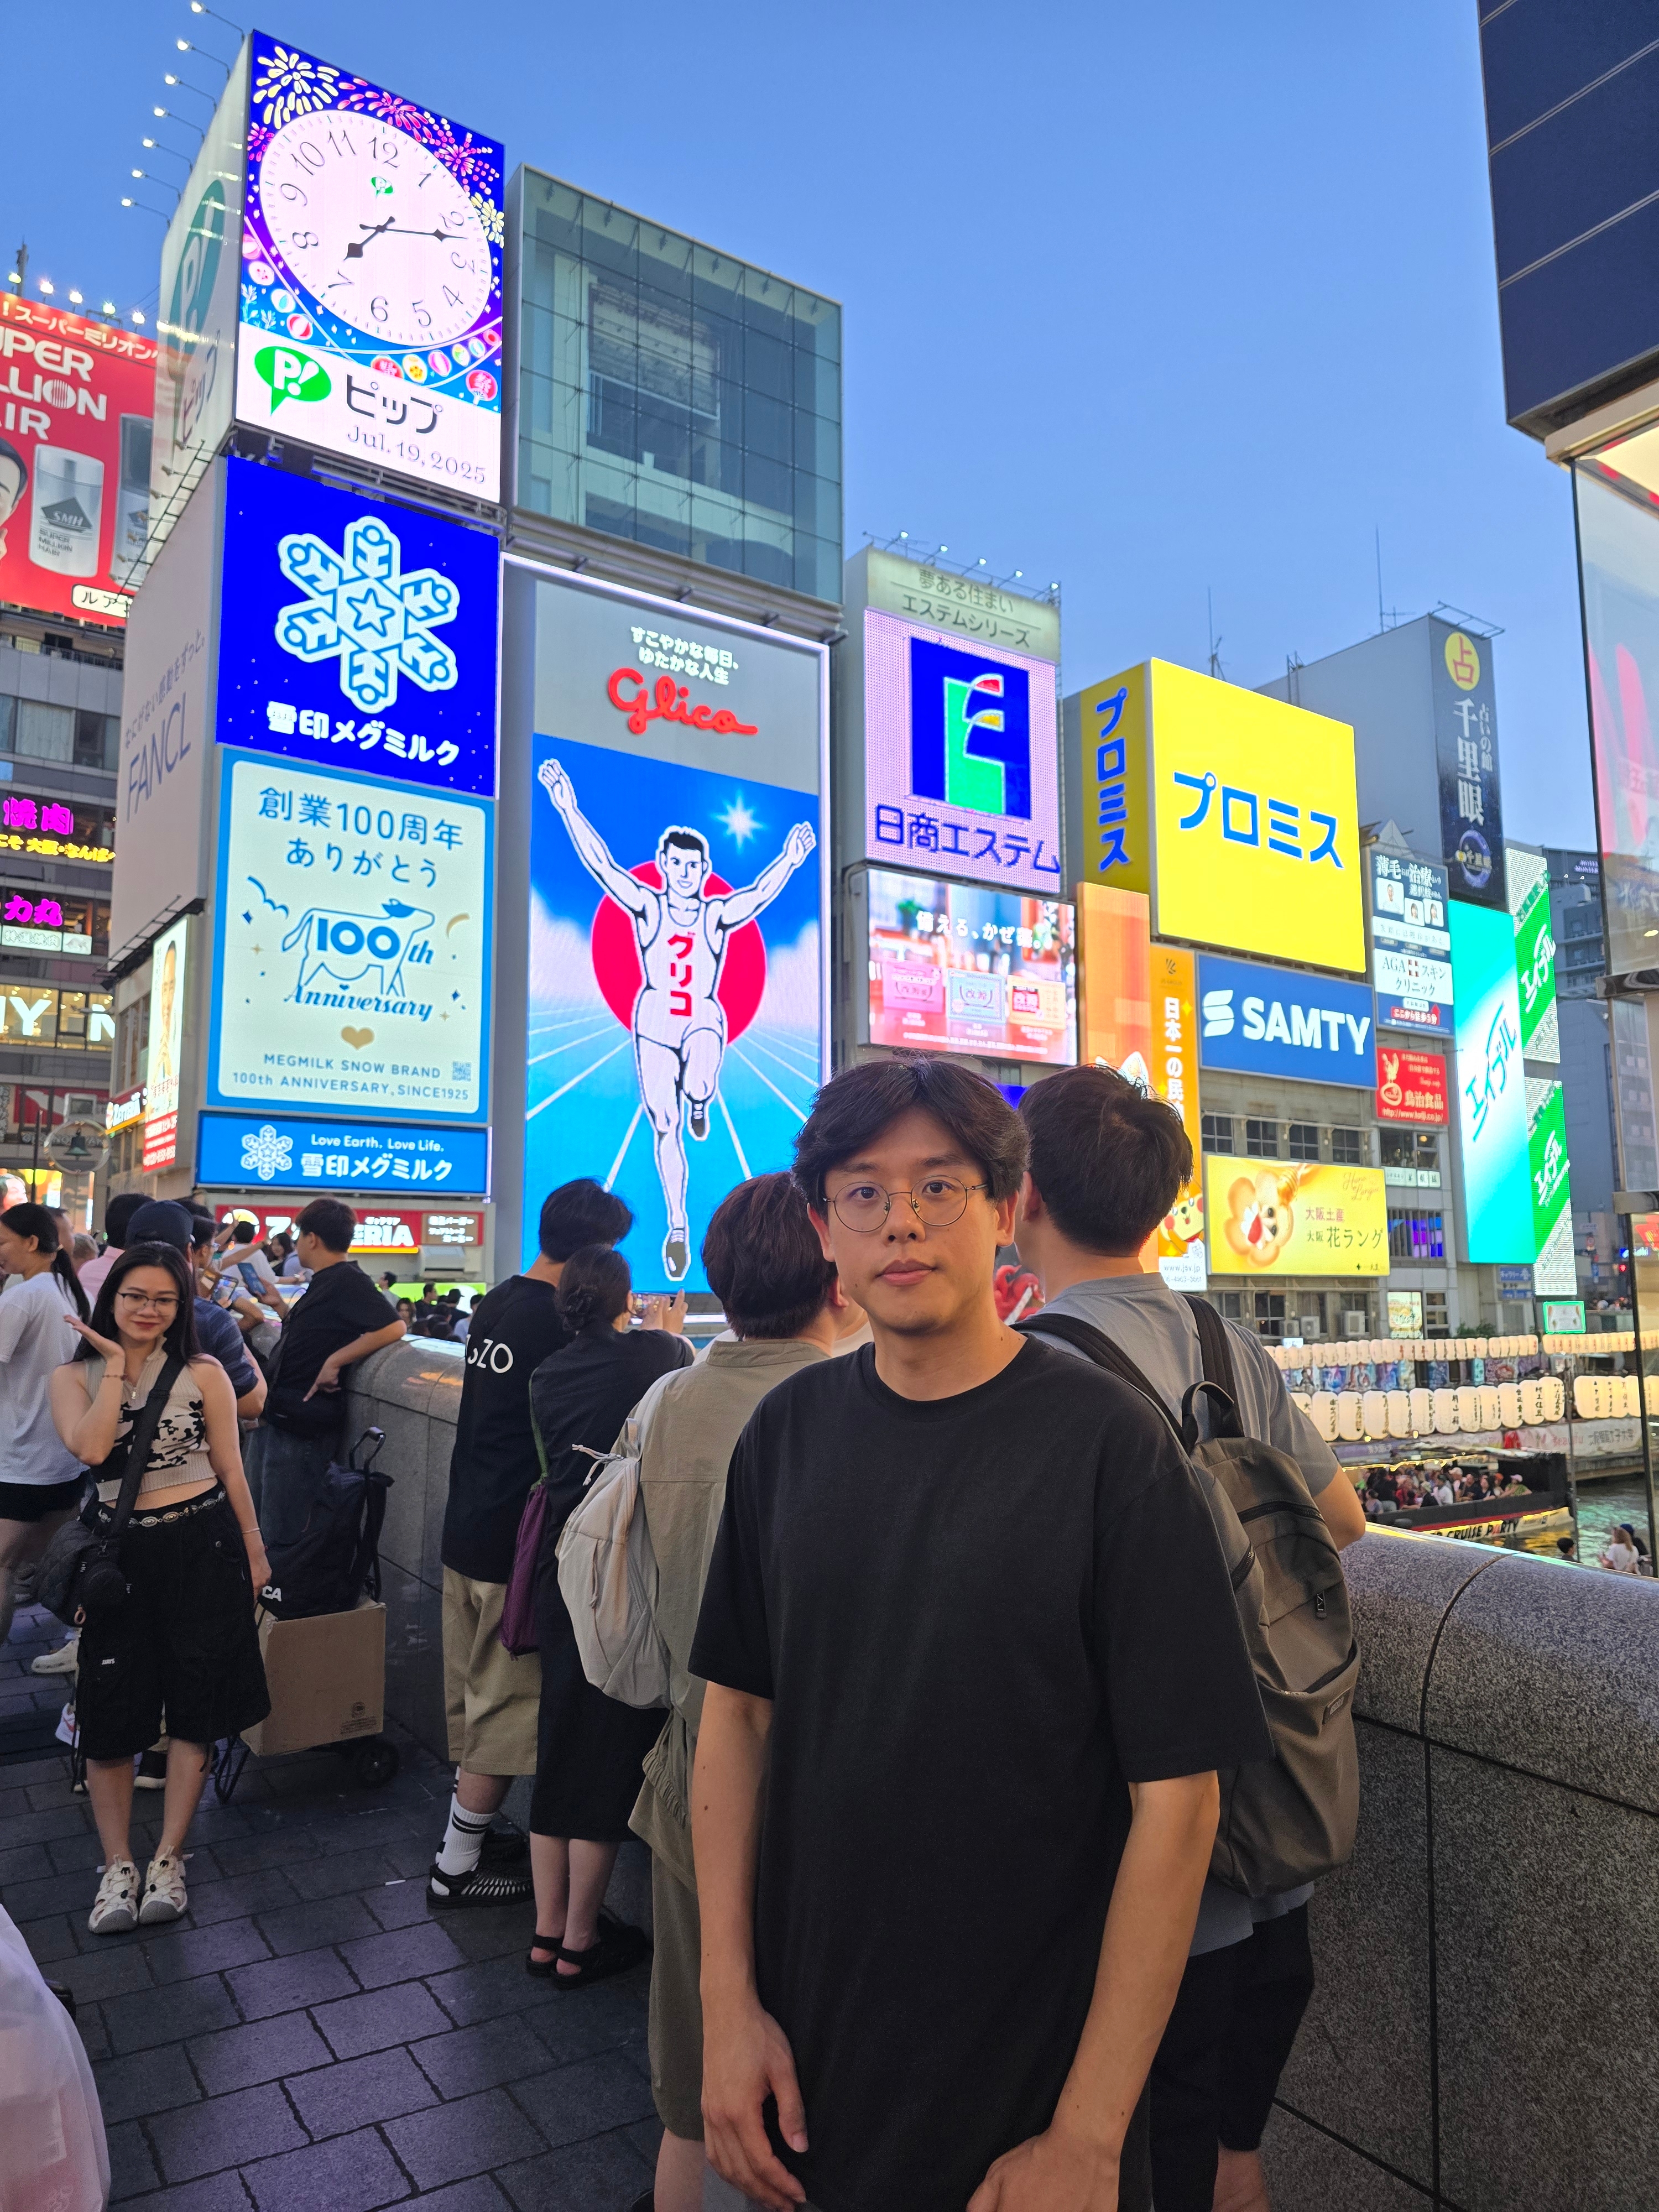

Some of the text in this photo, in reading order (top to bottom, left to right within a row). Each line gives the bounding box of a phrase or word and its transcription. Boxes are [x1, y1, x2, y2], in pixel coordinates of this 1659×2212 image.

[291, 142, 325, 176] 10
[369, 136, 399, 168] 12
[280, 182, 307, 207] 9
[293, 232, 319, 249] 8
[371, 296, 388, 322] 6
[412, 299, 432, 327] 5
[442, 285, 463, 307] 4
[0, 405, 51, 441] IR
[347, 374, 444, 434] ピップ
[919, 569, 1014, 614] 夢ある住まい
[902, 594, 1030, 648] エステムシリーズ
[630, 627, 739, 670] すこやかな毎日、
[639, 646, 729, 685] ゆたかな人生
[1453, 636, 1473, 684] 占
[609, 667, 759, 734] Glico
[267, 701, 460, 766] 雪印メグミルク
[126, 692, 191, 823] FANCL
[1453, 698, 1484, 827] 千里眼
[1097, 686, 1131, 873] プロミス
[258, 786, 463, 851] 創業100周年
[1173, 771, 1345, 869] プロミス
[875, 804, 1061, 873] 日商エステム
[286, 838, 437, 888] ありがとう
[4, 895, 63, 926] 力丸
[317, 919, 434, 964] 100 th
[667, 931, 694, 1017] グリコ
[1382, 957, 1406, 973] AGA
[284, 985, 432, 1021] Anniversary
[1395, 978, 1435, 997] クリニック
[0, 997, 52, 1036] Y
[1242, 997, 1371, 1055] SAMTY
[233, 1073, 273, 1086] 100th
[264, 1054, 441, 1078] MEGMILK SNOW BRAND
[1465, 1018, 1517, 1123] エイブル
[311, 1134, 444, 1152] Love Earth. Love Life.
[301, 1154, 452, 1181] 雪印メグミルク
[1306, 1207, 1344, 1222] 大阪土産
